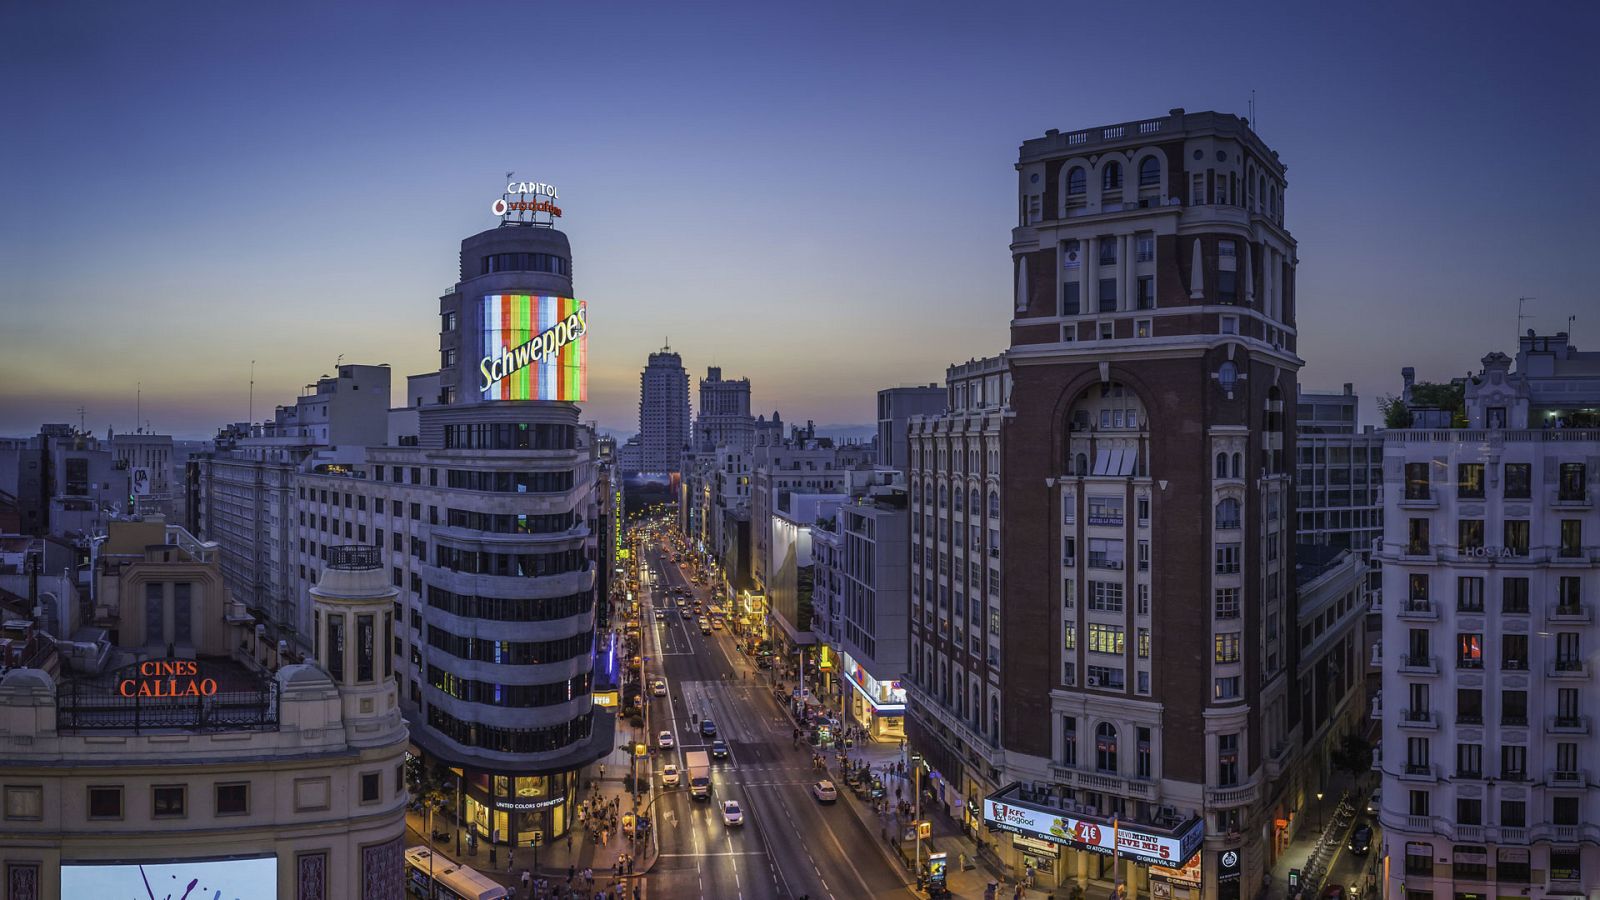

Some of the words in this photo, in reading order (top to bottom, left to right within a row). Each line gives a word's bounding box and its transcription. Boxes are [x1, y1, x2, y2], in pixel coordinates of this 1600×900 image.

[507, 181, 559, 199] CAPITOL
[508, 198, 562, 218] vodafone
[480, 307, 587, 393] Schweppes
[1465, 546, 1521, 558] HOSTAL
[141, 661, 198, 676] CINES
[120, 678, 218, 697] CALLAO
[496, 801, 514, 809] UNITED
[543, 796, 565, 807] BENETTON
[1008, 809, 1026, 818] KFC
[1080, 825, 1097, 843] 4€
[1118, 830, 1132, 839] UEVO
[1142, 842, 1158, 852] ME
[1159, 845, 1170, 859] 5
